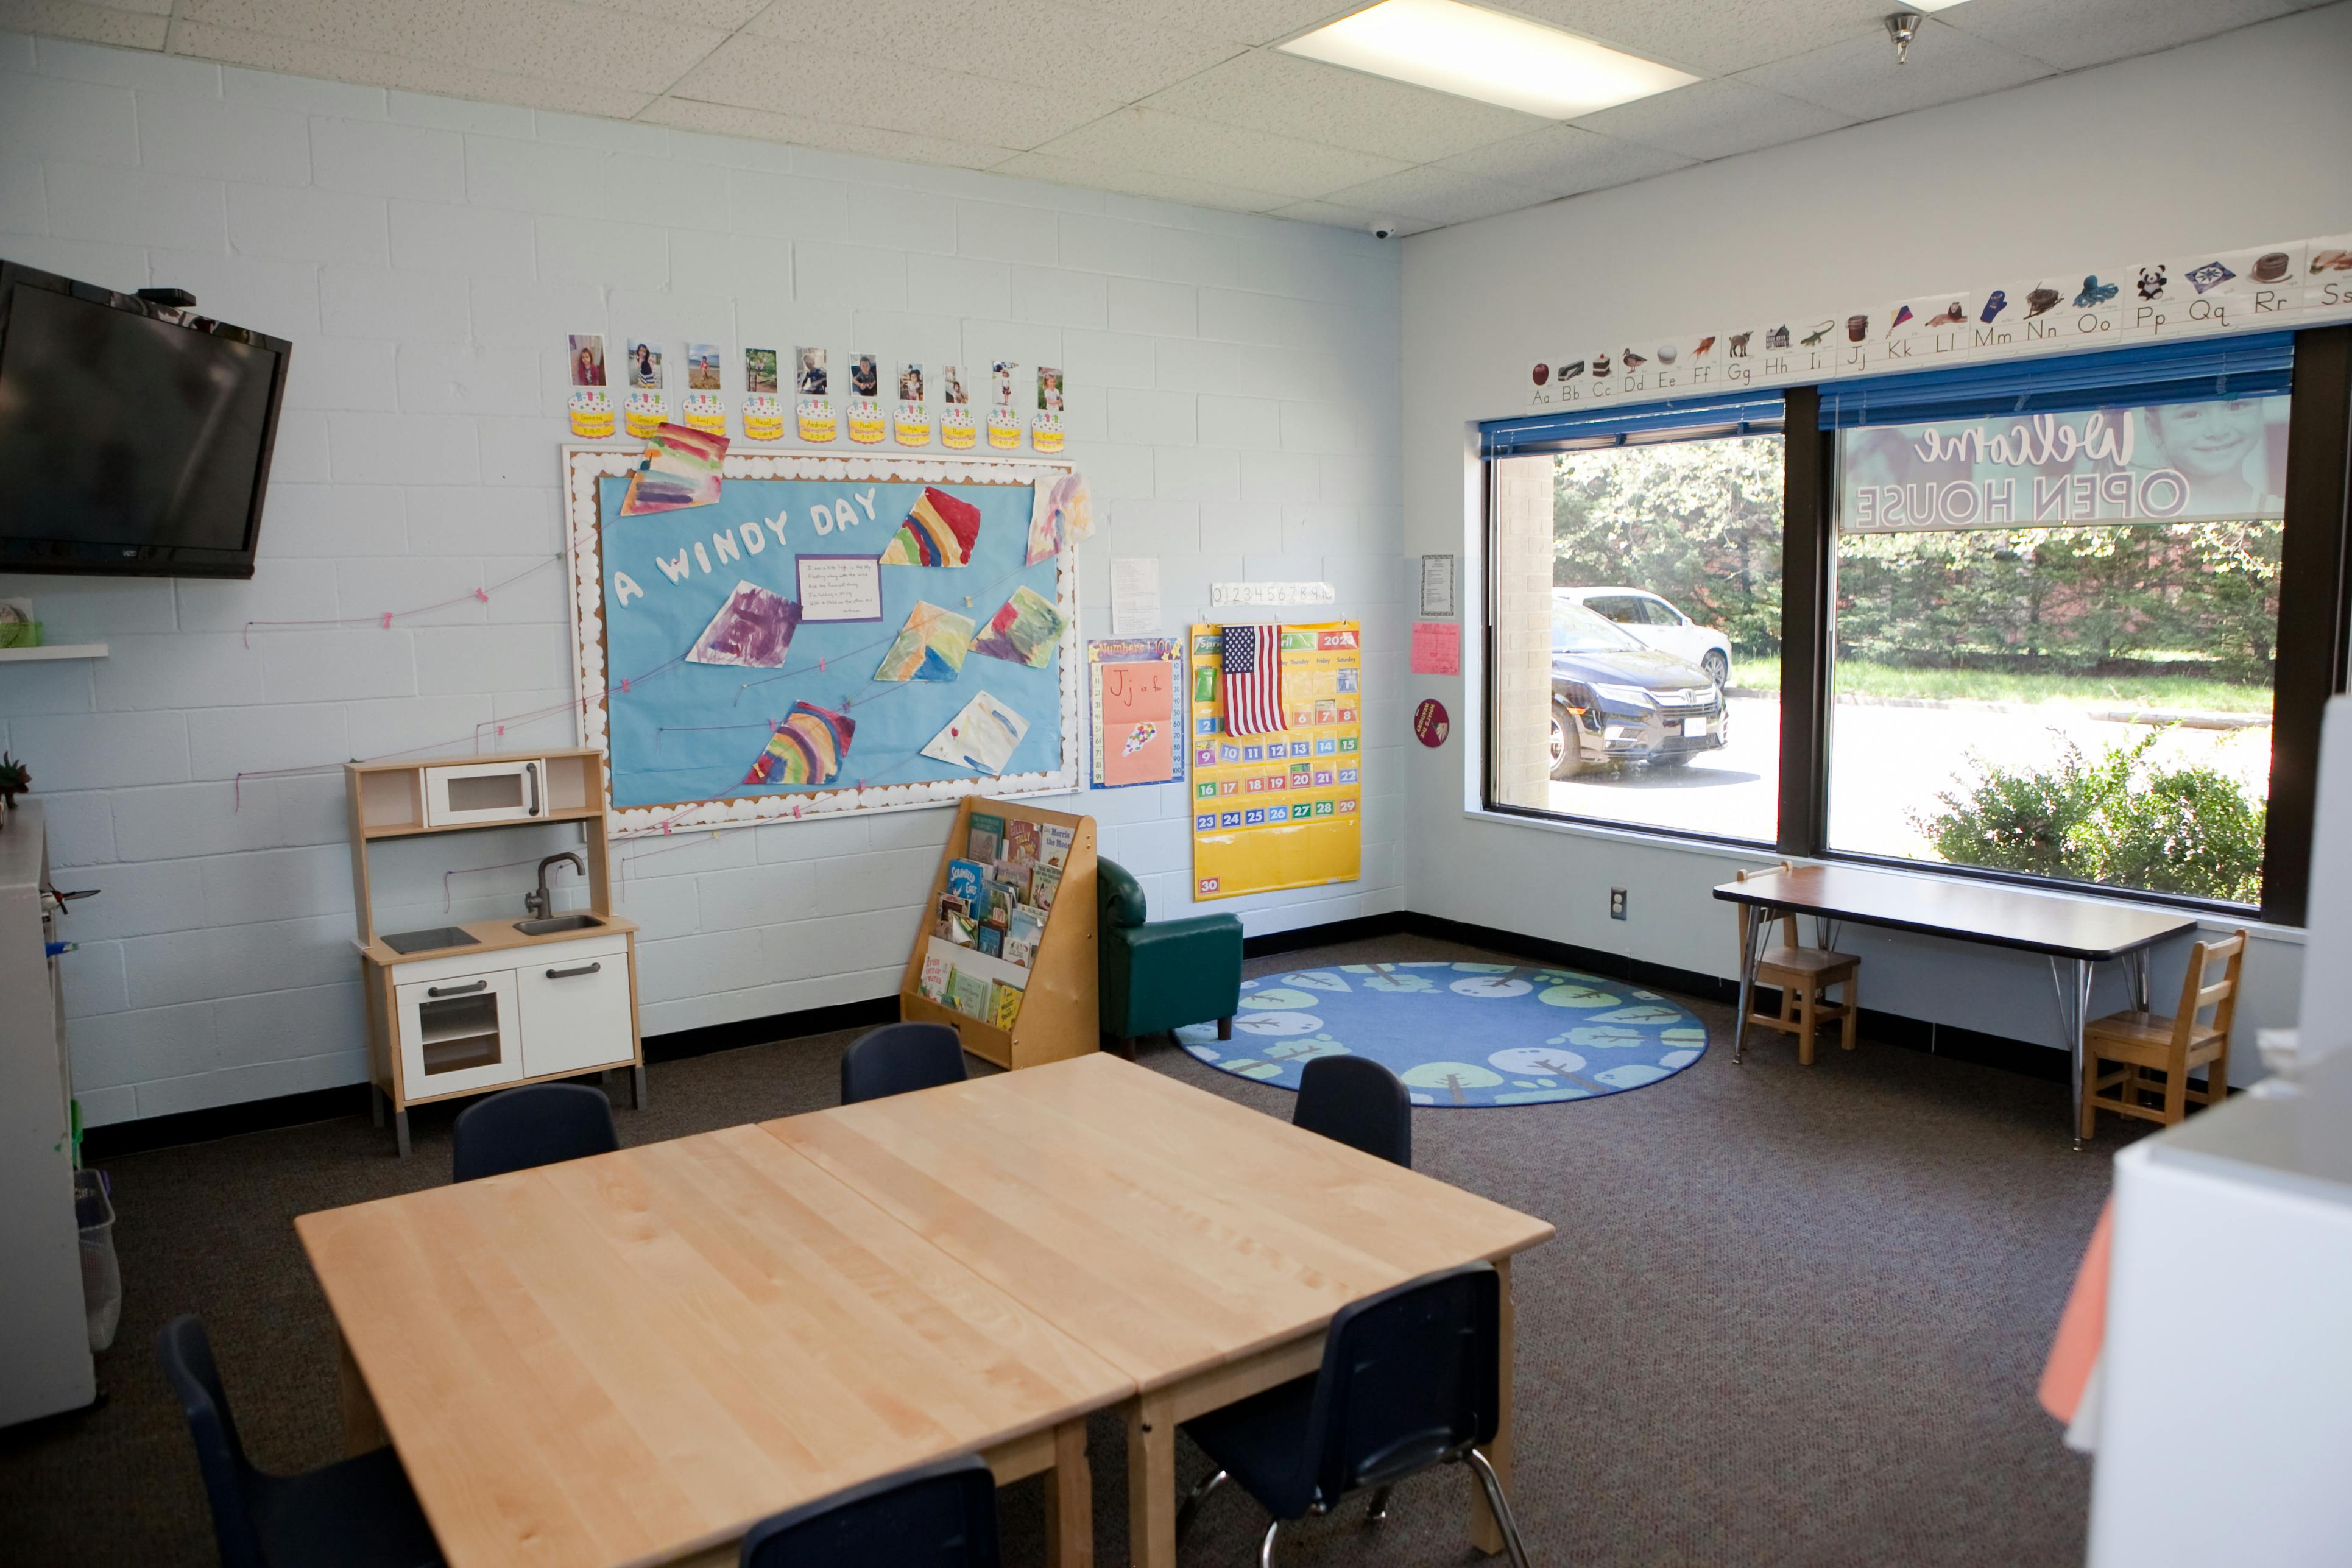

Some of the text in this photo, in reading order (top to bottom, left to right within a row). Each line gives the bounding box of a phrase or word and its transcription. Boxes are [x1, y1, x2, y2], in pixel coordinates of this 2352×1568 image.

[1532, 283, 2352, 405] Aa Bb Cc Dd Ee Ff Gg Hh Ii Jj Kk Ll Mm Nn Oo Pp Qq Rr Ss
[807, 420, 828, 428] Andrew
[614, 487, 876, 608] A WINDY DAY
[1213, 588, 1221, 602] 0
[1233, 588, 1240, 602] 2
[1243, 587, 1251, 601] 3
[1255, 587, 1262, 601] 4
[1267, 587, 1274, 601] 5
[1279, 587, 1285, 601] 6
[1290, 587, 1296, 601] 7
[1300, 587, 1307, 601] 8
[1311, 587, 1318, 600] 9
[1099, 641, 1145, 655] Numbers
[1200, 639, 1222, 650] Spri
[1280, 637, 1293, 646] ril
[1344, 679, 1350, 689] 1
[1203, 710, 1351, 730] 2 6 7 8
[1202, 740, 1355, 762] 9 10 11 12 13 14 15
[1201, 771, 1356, 795] 16 17 18 19 20 21 22
[1198, 800, 1355, 828] 23 24 25 26 27 28 29
[1010, 823, 1025, 837] SILLY
[1051, 828, 1070, 839] Morris
[1015, 831, 1031, 844] TILLY
[1047, 838, 1070, 849] the Moo
[950, 867, 975, 883] SCRAMBLED
[966, 881, 978, 895] EGGS
[1201, 880, 1218, 891] 30
